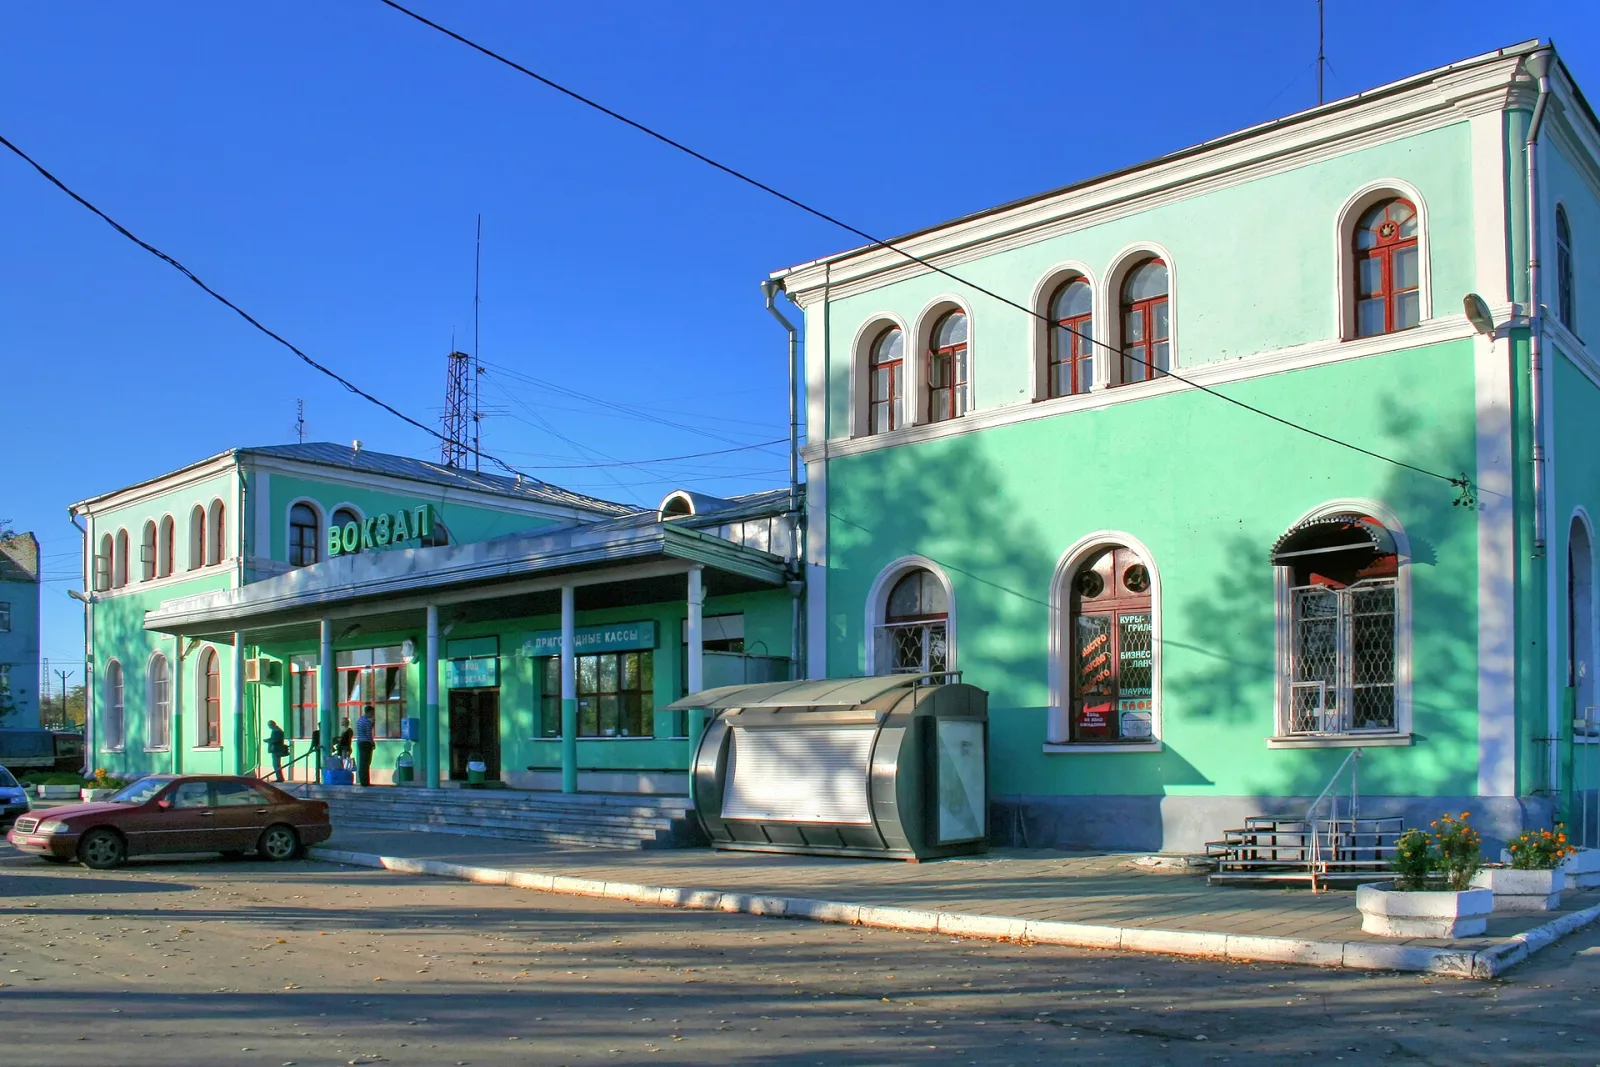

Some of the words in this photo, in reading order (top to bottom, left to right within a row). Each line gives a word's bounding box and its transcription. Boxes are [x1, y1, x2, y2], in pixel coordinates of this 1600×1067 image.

[328, 504, 431, 556] ВОКЗАЛ
[604, 630, 638, 643] КАССЫ
[1120, 650, 1151, 660] БИЗНЕС
